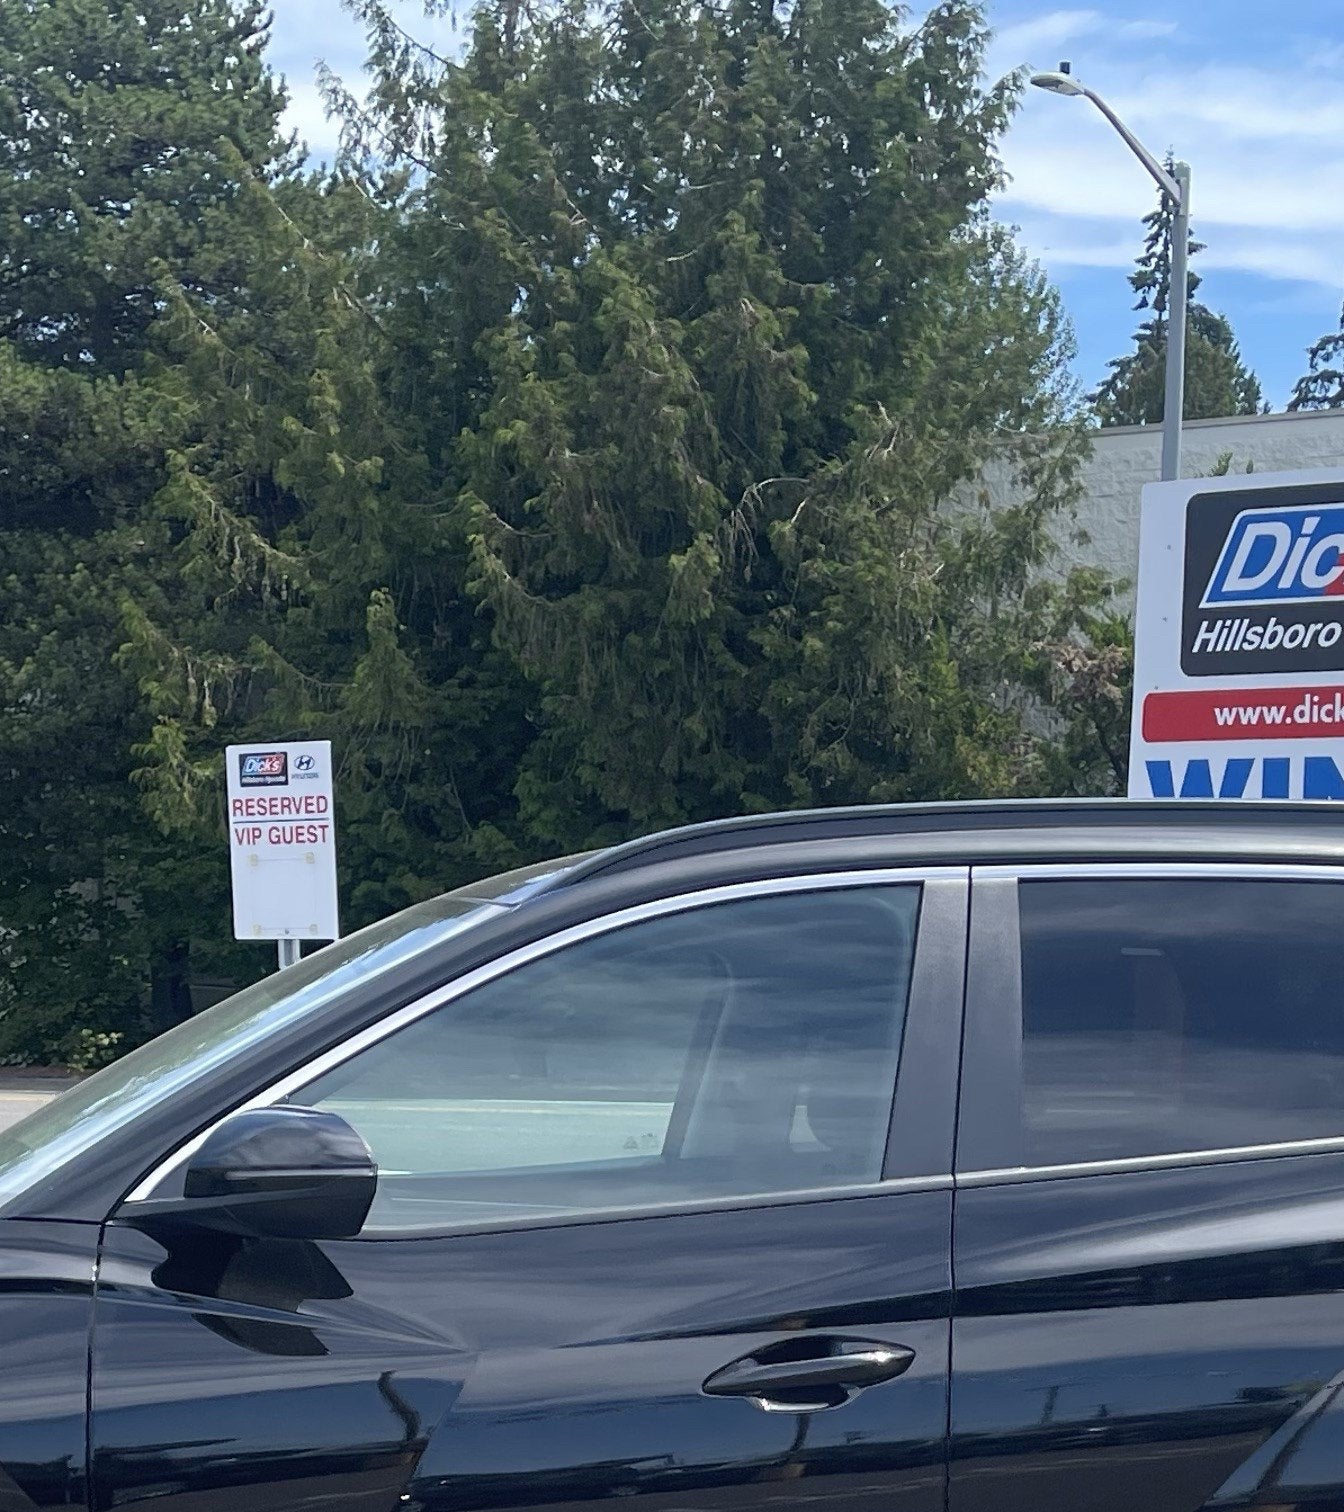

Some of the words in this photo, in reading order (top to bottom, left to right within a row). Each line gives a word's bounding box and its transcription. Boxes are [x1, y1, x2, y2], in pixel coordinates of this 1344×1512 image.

[1191, 613, 1343, 653] Hillsboro
[232, 796, 328, 817] RESERVED
[234, 828, 262, 845] VIP
[268, 825, 329, 845] GUEST
